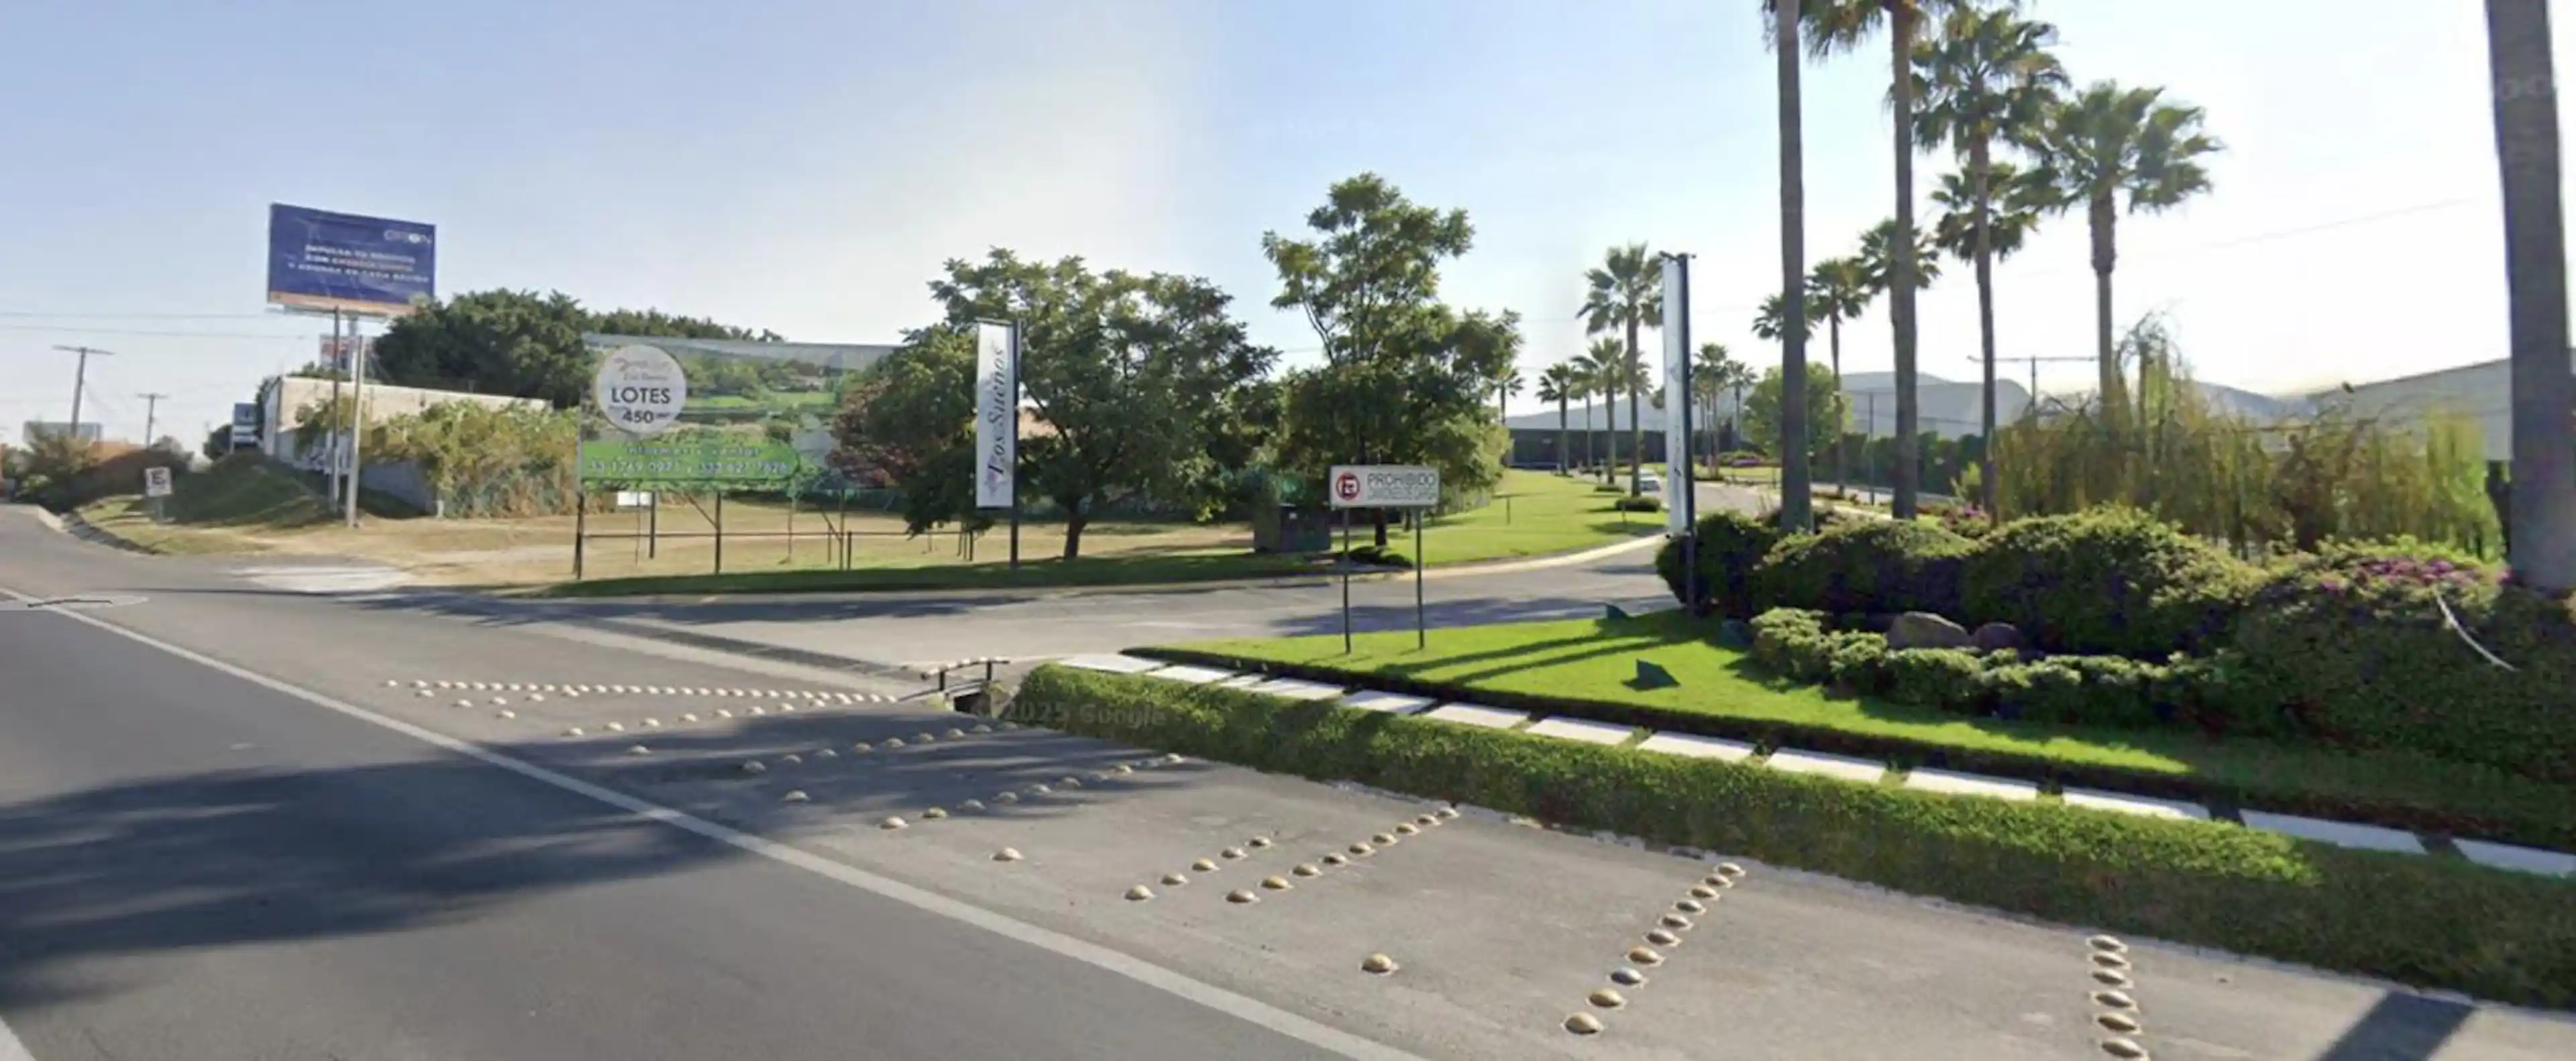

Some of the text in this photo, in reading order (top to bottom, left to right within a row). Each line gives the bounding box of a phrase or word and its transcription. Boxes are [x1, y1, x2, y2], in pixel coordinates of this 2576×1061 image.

[611, 386, 671, 404] LOTES
[622, 410, 655, 424] 450
[1367, 472, 1436, 487] PROHIBIDO
